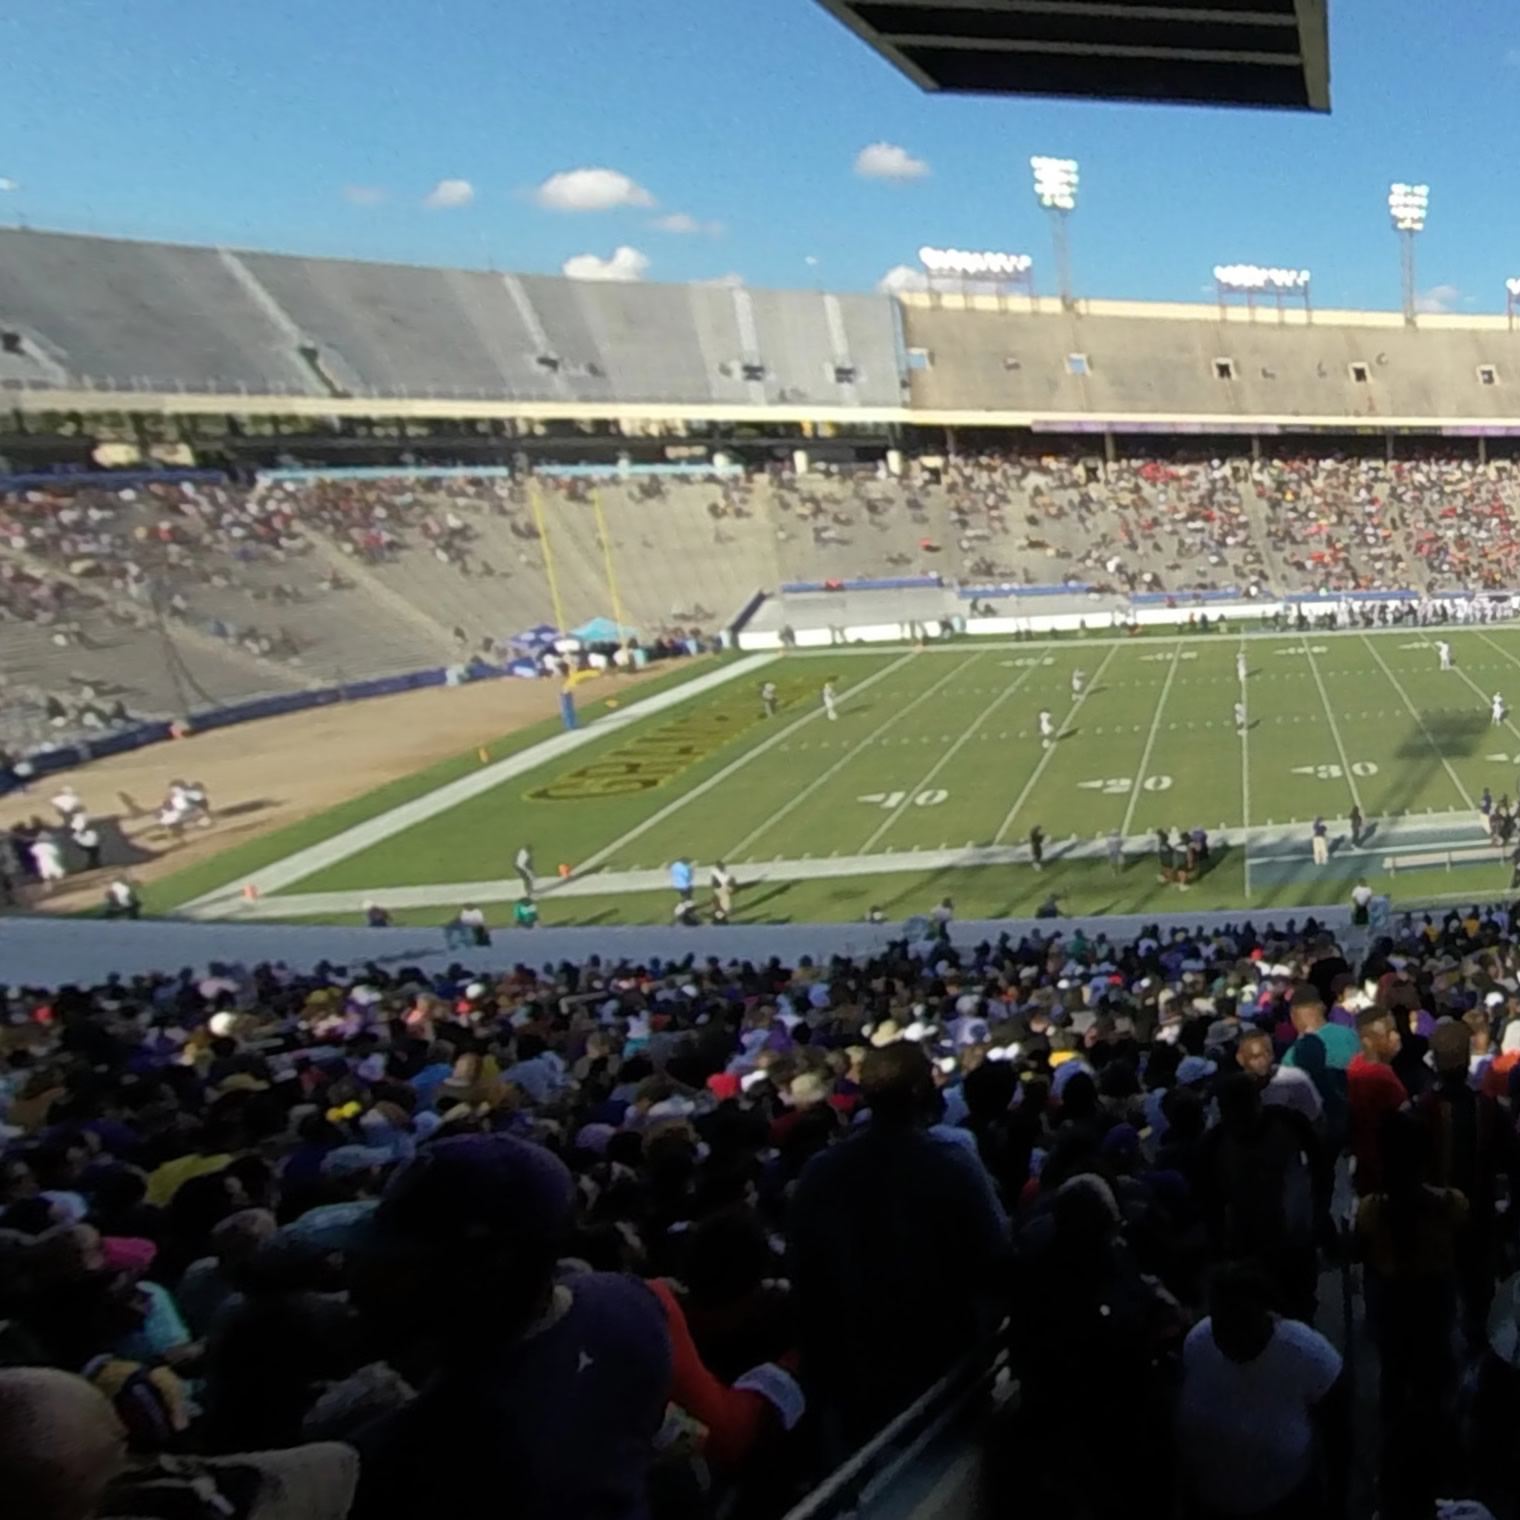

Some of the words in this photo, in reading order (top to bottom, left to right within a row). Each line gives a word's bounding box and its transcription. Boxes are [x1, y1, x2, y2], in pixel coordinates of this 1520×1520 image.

[1317, 761, 1379, 779] 30
[1102, 775, 1172, 793] 20
[879, 789, 948, 808] 10
